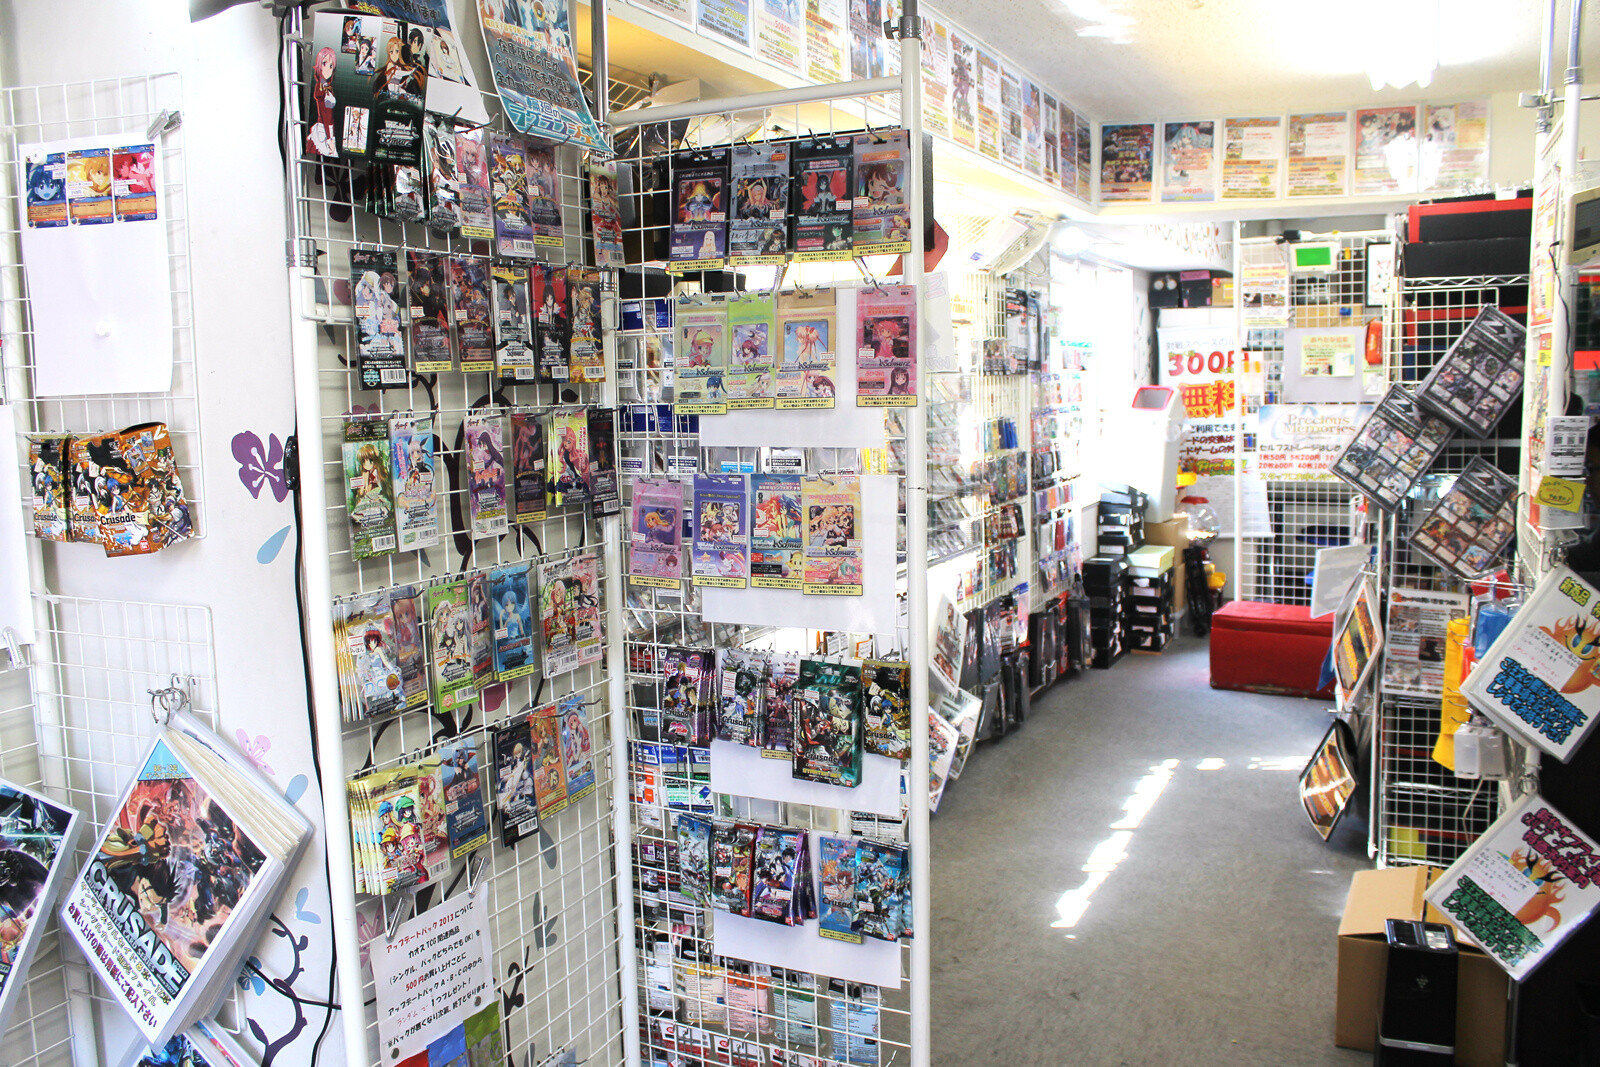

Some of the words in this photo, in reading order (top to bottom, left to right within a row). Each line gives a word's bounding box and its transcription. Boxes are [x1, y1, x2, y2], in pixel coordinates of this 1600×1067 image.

[1288, 414, 1350, 426] Precious
[1284, 422, 1356, 435] Memories
[34, 512, 57, 522] Crusade
[100, 512, 136, 526] Crusade
[1559, 576, 1592, 607] 新商品
[664, 708, 694, 718] Crusade
[721, 716, 754, 728] Crusade
[866, 729, 898, 742] Crusade
[805, 752, 840, 764] Crusade
[714, 888, 744, 901] Crusade
[822, 898, 852, 909] Crusad
[89, 860, 184, 992] CRUSADE
[80, 898, 158, 1006] シングルカード販売ファイル
